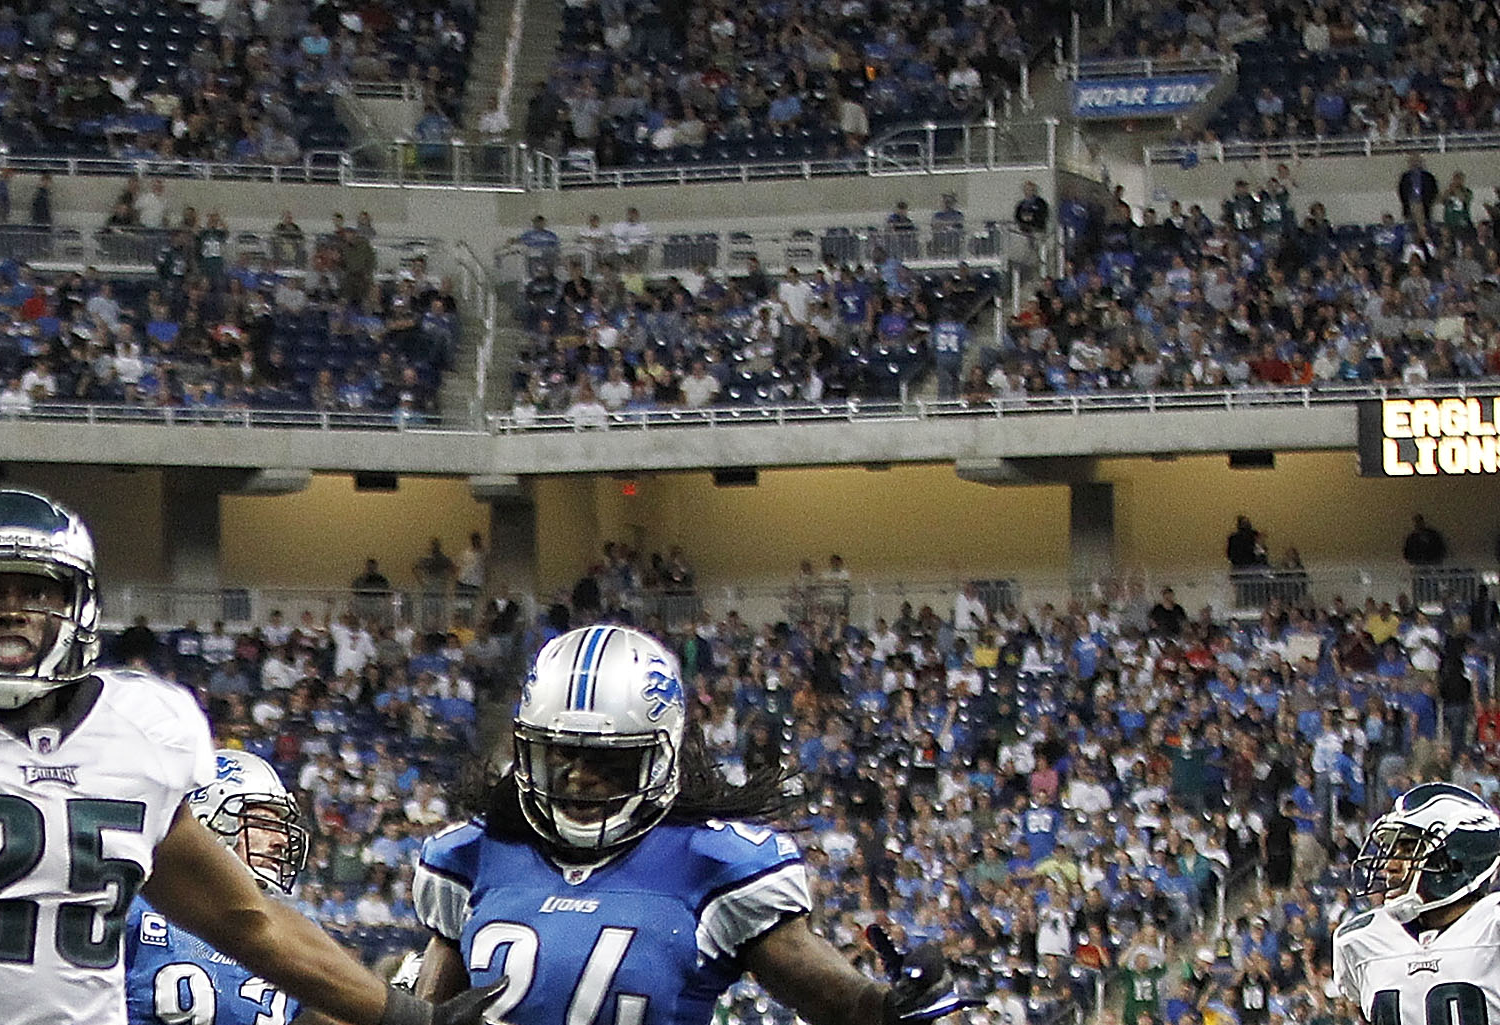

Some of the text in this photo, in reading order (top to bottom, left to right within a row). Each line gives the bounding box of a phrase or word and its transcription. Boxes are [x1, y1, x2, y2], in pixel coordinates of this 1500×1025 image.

[1382, 397, 1500, 437] EAGL
[1382, 436, 1500, 475] LION
[143, 916, 168, 938] C
